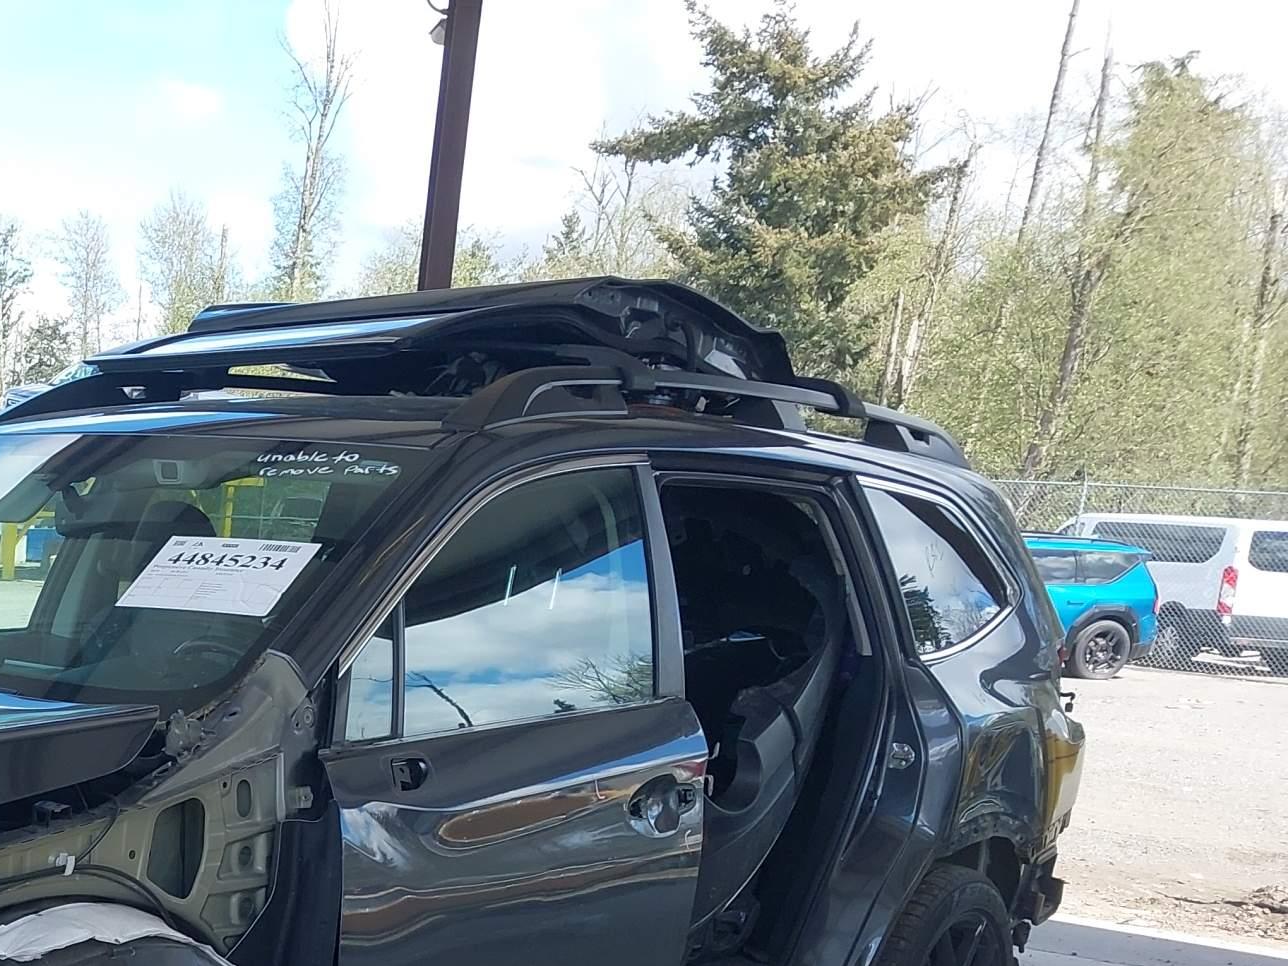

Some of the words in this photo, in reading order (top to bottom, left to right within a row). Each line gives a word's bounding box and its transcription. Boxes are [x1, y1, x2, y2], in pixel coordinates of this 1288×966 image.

[257, 450, 328, 462] unable
[331, 450, 360, 464] to
[259, 466, 334, 476] remove
[167, 551, 289, 571] 44845234
